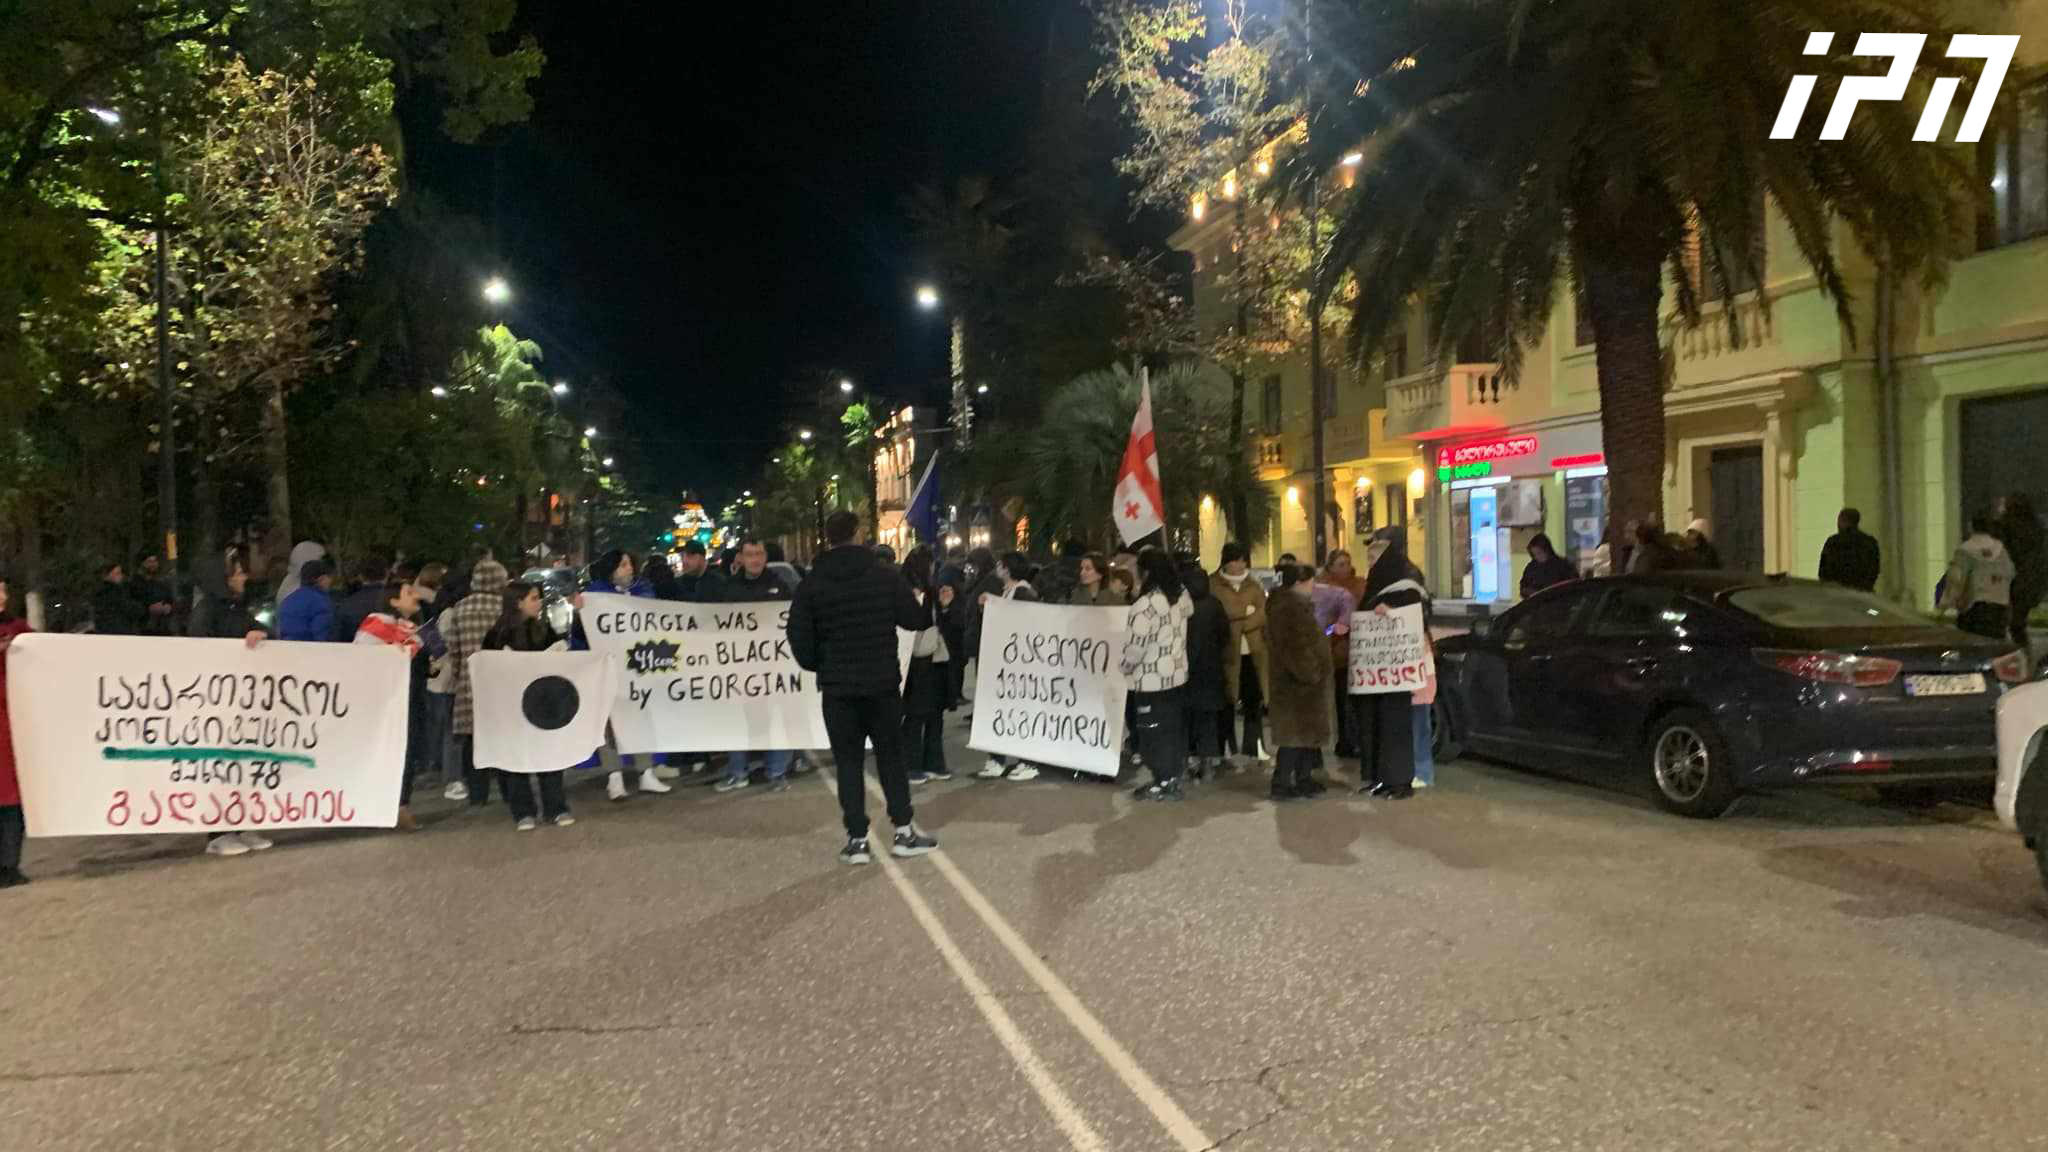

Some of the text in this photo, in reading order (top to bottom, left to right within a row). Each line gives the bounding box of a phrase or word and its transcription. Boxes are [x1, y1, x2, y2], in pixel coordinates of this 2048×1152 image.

[596, 612, 699, 634] GEORGIA
[714, 611, 758, 631] WAS
[686, 654, 708, 666] on
[716, 639, 790, 665] BLACK
[98, 673, 350, 718] საქართველოს
[629, 671, 802, 709] by GEORGIAN
[996, 667, 1077, 708] ქვეყანა
[95, 715, 319, 749] კონსტიტუცია
[992, 708, 1111, 749] გაგიყიდეს
[250, 760, 281, 790] 78
[107, 790, 356, 827] გადაგვახიეს
